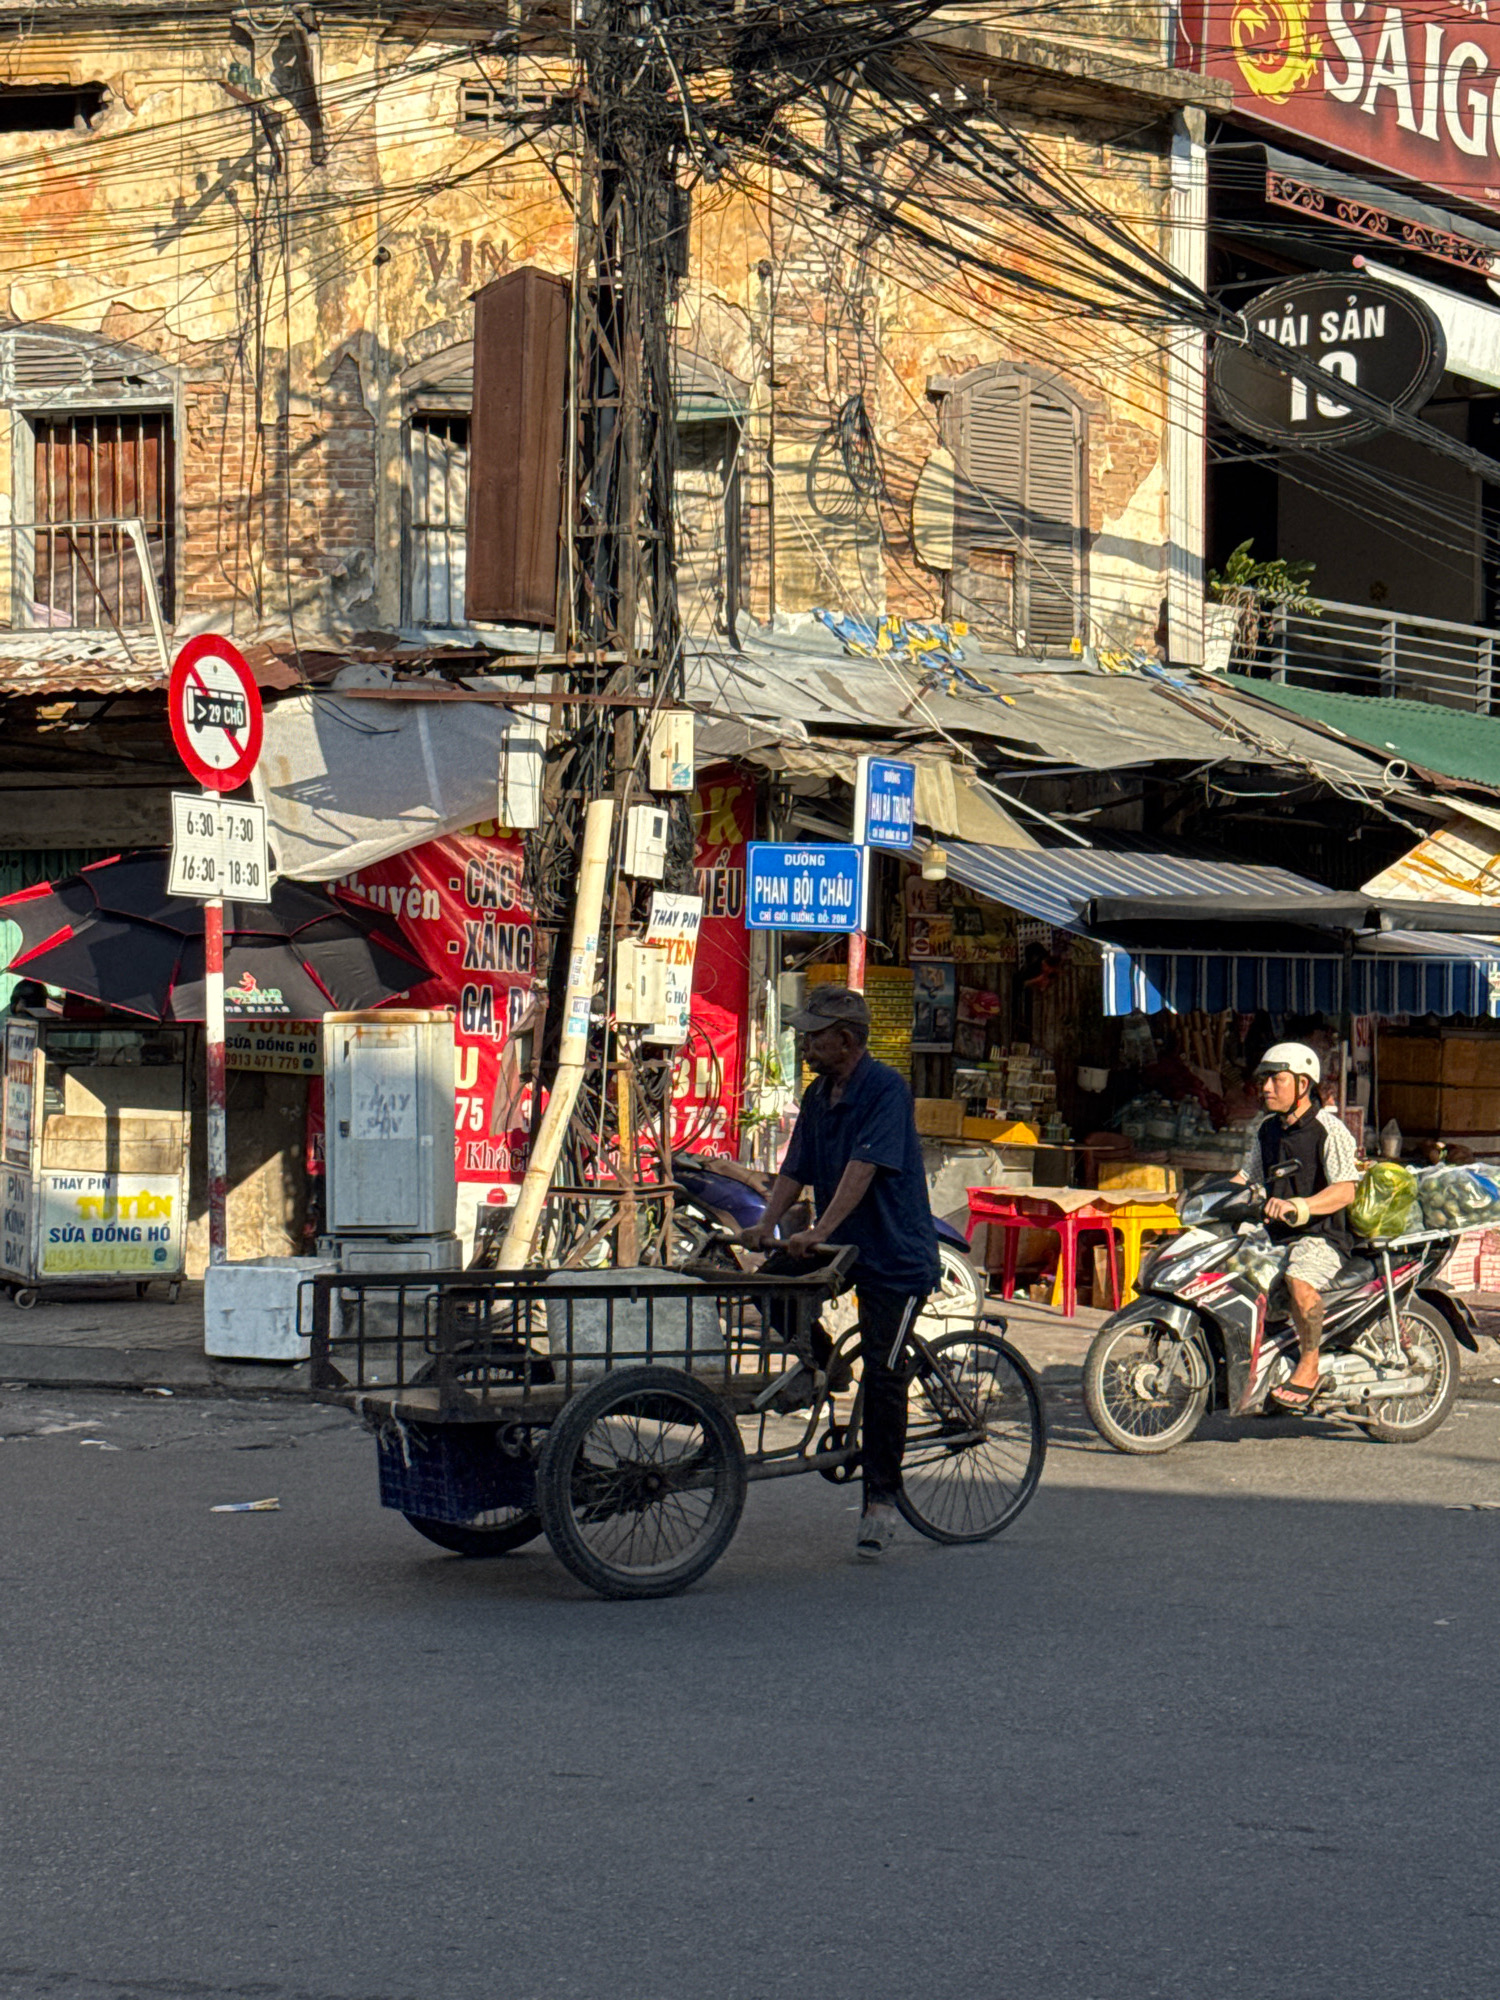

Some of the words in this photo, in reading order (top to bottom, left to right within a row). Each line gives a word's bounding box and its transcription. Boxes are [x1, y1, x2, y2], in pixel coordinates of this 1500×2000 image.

[1324, 0, 1500, 160] SAIG
[1319, 295, 1386, 344] SẢN
[208, 703, 221, 723] 29
[187, 811, 214, 838] 6:30
[227, 815, 253, 842] 7:30
[182, 855, 215, 882] 16:30
[228, 859, 259, 887] 18:30
[754, 875, 788, 905] PHAN
[793, 870, 813, 910] BỘI
[819, 871, 853, 907] CHÂU
[652, 909, 678, 928] THAY
[680, 912, 699, 928] PIN
[462, 911, 532, 974] XĂNG
[52, 1177, 84, 1190] THAY
[87, 1177, 111, 1190] PIN
[76, 1189, 174, 1220] TUYÊN
[49, 1222, 86, 1243] SỬA
